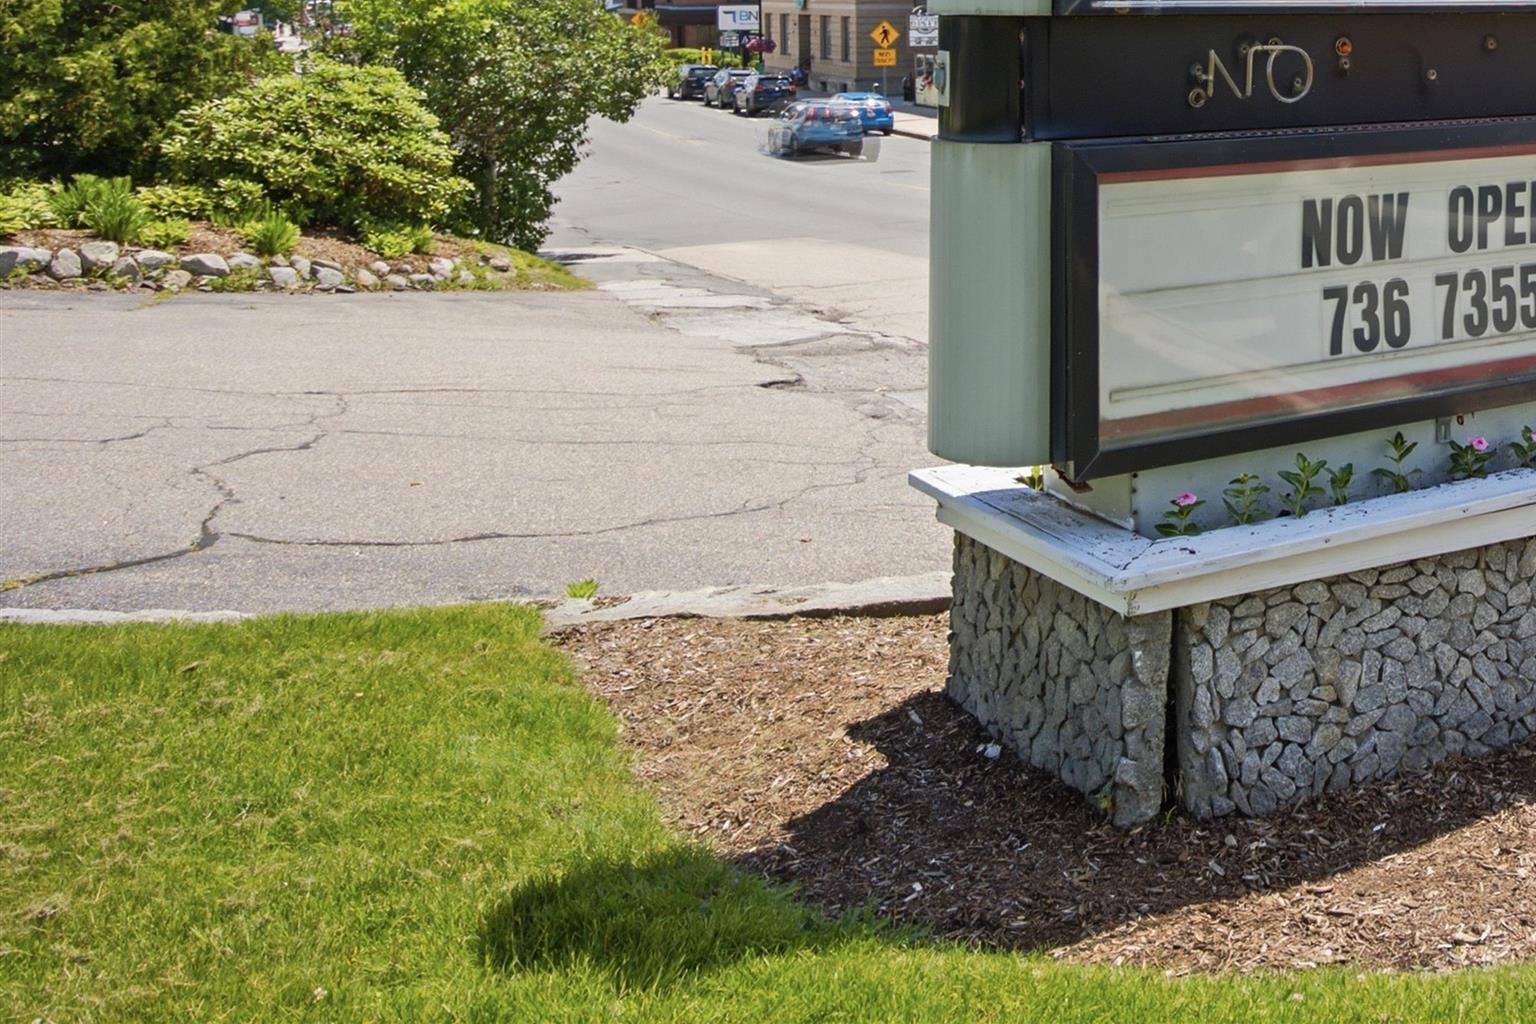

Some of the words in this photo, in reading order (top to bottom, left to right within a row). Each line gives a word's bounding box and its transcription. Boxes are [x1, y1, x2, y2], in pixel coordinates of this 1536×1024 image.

[1207, 44, 1315, 104] NO
[1300, 192, 1410, 269] NOW
[1322, 279, 1411, 357] 736
